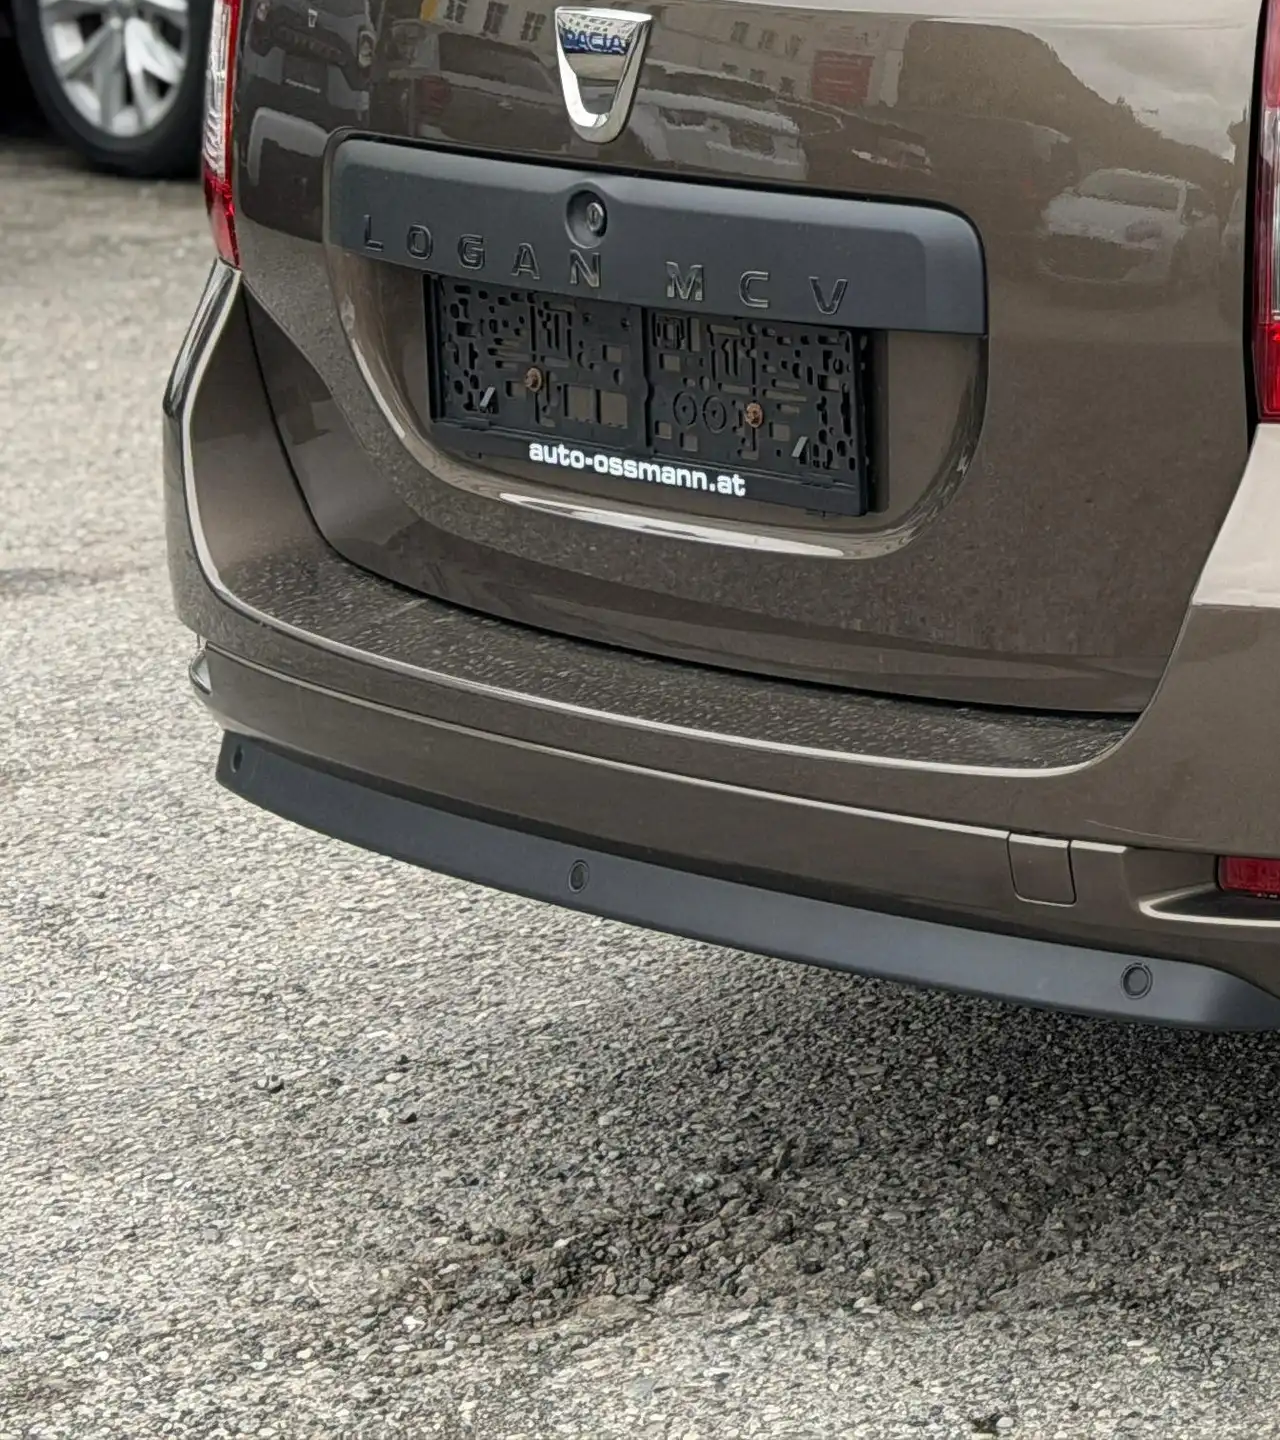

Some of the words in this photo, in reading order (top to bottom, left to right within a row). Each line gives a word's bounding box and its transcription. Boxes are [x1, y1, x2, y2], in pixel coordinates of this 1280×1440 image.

[563, 28, 629, 54] DACIA
[363, 214, 601, 288] LOGAN
[665, 261, 849, 315] MCV
[528, 442, 747, 498] auto-ossmann.at
